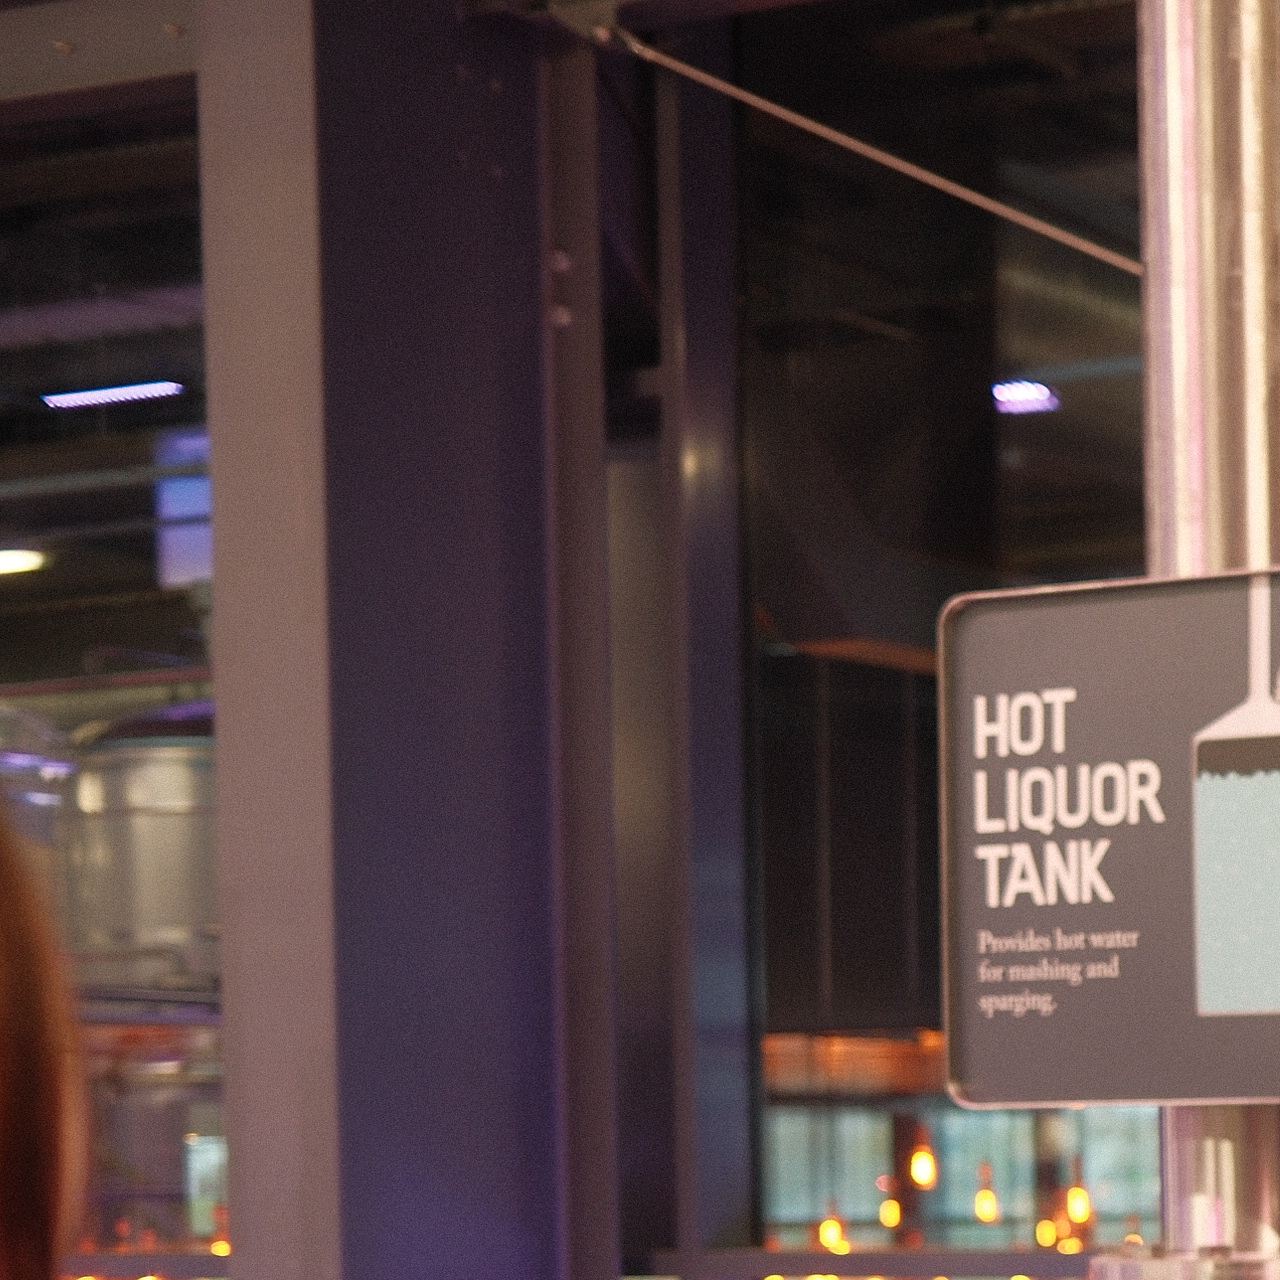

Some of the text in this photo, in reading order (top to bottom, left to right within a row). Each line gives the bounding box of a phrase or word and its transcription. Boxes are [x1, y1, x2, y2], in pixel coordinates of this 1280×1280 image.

[973, 687, 1077, 759] HOT
[973, 759, 1166, 835] LIQUOR
[974, 838, 1116, 908] TANK
[977, 926, 1140, 954] Provides hot water
[978, 953, 1120, 987] for mashing and
[978, 989, 1058, 1018] sparging.
